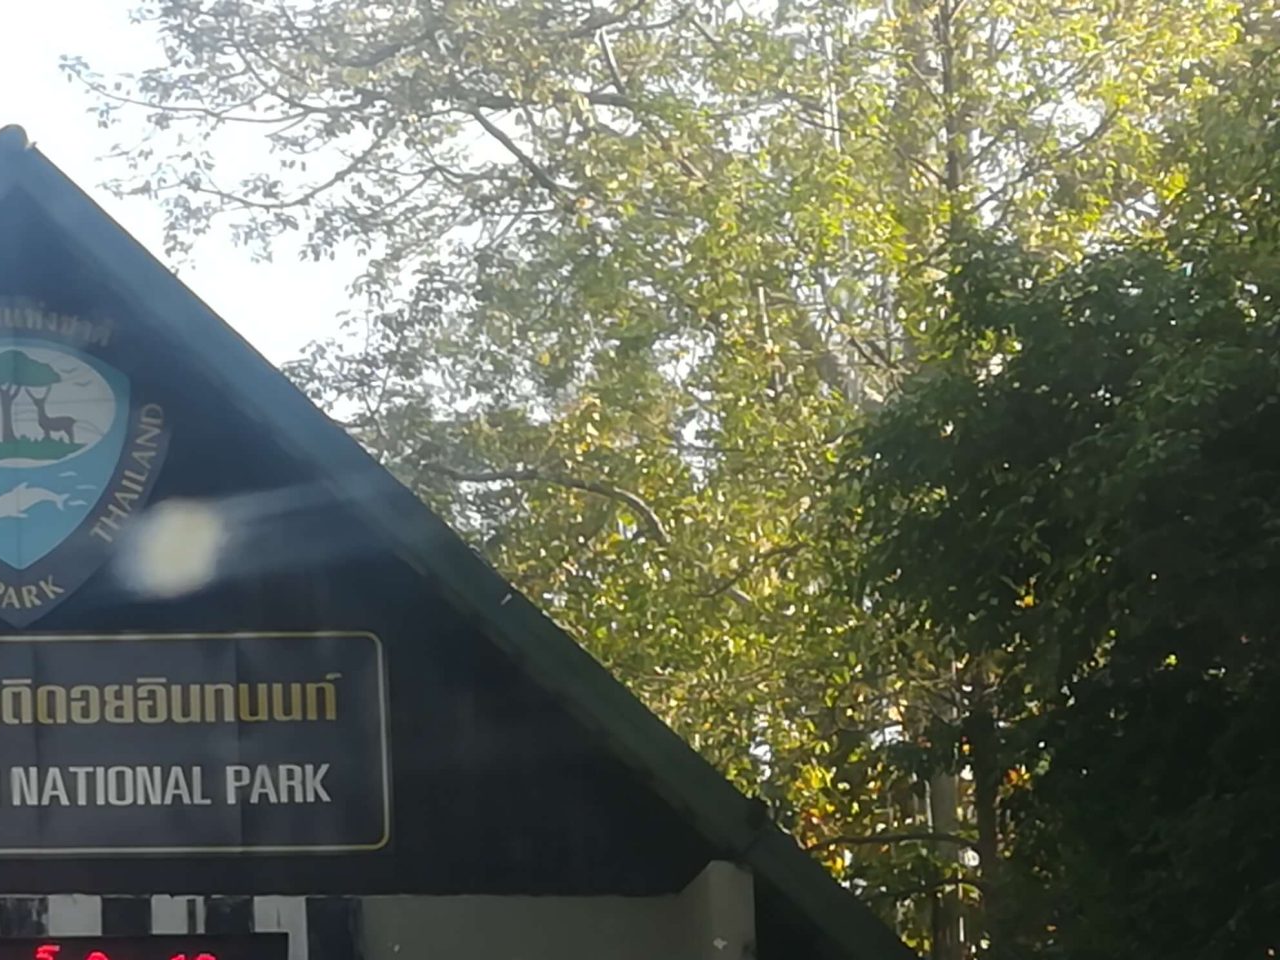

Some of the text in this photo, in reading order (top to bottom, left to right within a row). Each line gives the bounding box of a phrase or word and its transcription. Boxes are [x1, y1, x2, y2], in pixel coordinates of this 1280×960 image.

[89, 402, 165, 544] THAILAND
[10, 765, 213, 806] NATIONAL
[225, 762, 332, 805] PARK
